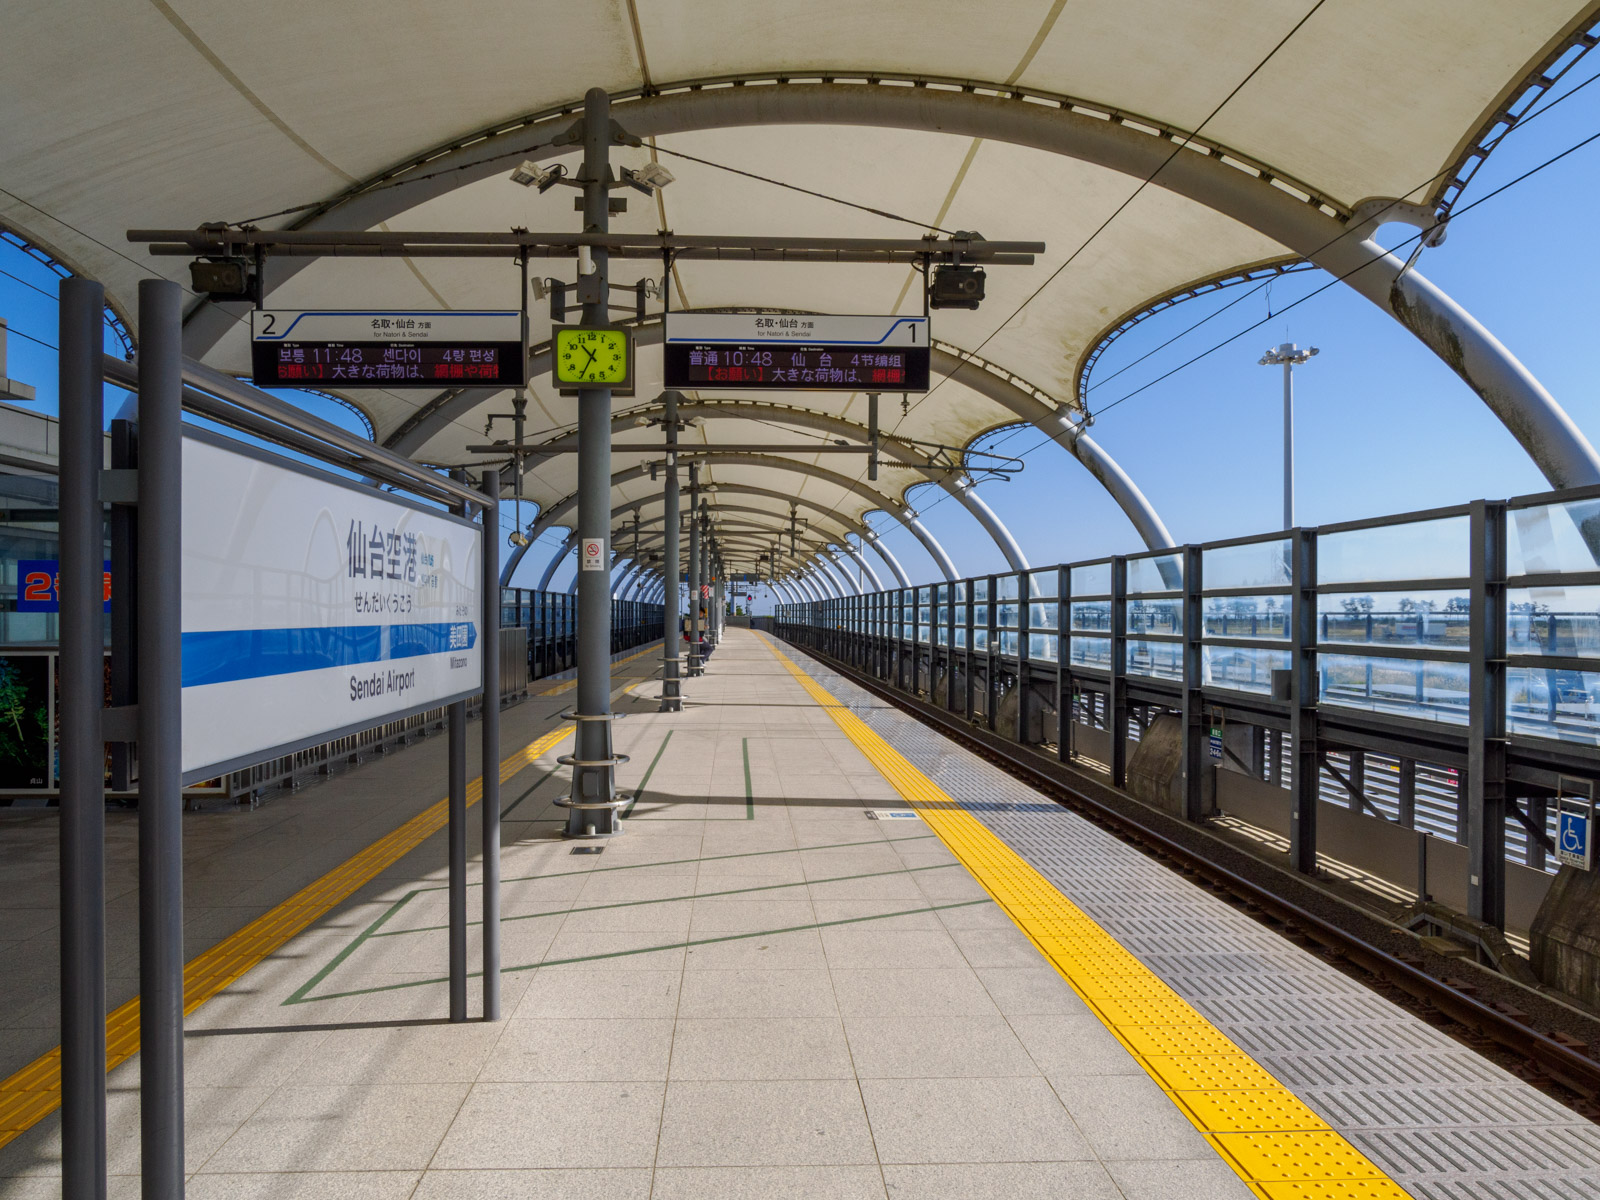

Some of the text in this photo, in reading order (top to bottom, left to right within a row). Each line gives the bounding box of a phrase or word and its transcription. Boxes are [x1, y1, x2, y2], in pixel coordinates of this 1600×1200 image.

[262, 314, 276, 335] 2
[371, 319, 432, 329] 名取・仙台 方面
[755, 318, 814, 329] 名取・仙台 方面
[907, 323, 916, 343] 1
[280, 348, 305, 363] 보통
[313, 348, 363, 363] 11:48
[383, 348, 421, 363] 센다이
[689, 350, 718, 366] 普通
[724, 351, 773, 366] 10:48
[347, 518, 417, 582] 仙台空港
[354, 591, 412, 613] せんだいくうこう
[350, 668, 415, 702] Sendai Airport
